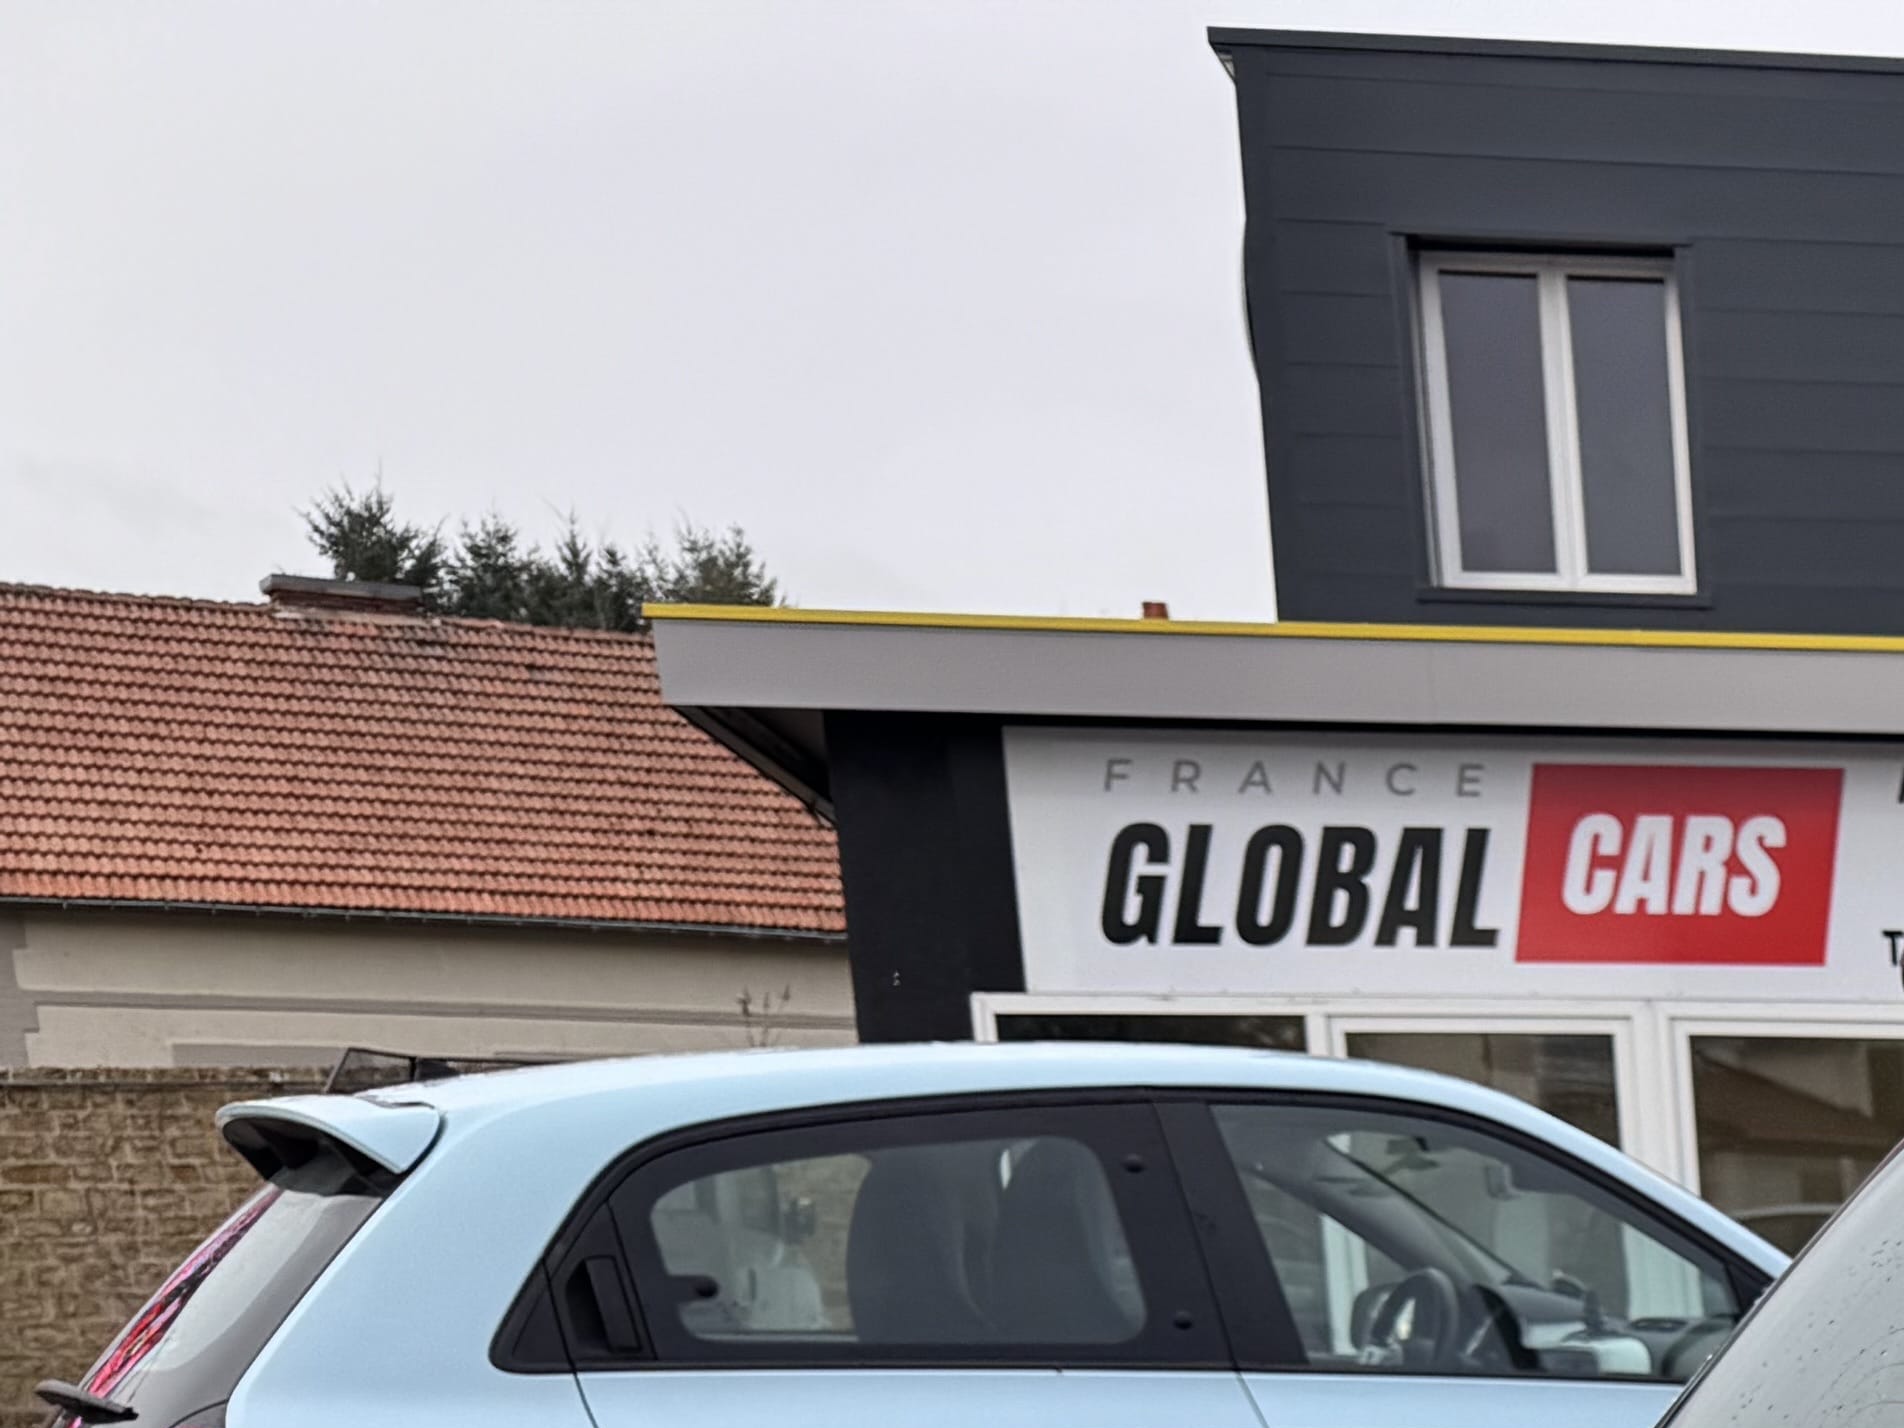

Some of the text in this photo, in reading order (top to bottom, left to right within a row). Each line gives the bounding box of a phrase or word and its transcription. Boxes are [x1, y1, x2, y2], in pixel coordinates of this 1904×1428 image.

[1103, 757, 1487, 798] FRANCE
[1101, 812, 1788, 947] GLOBAL CARS
